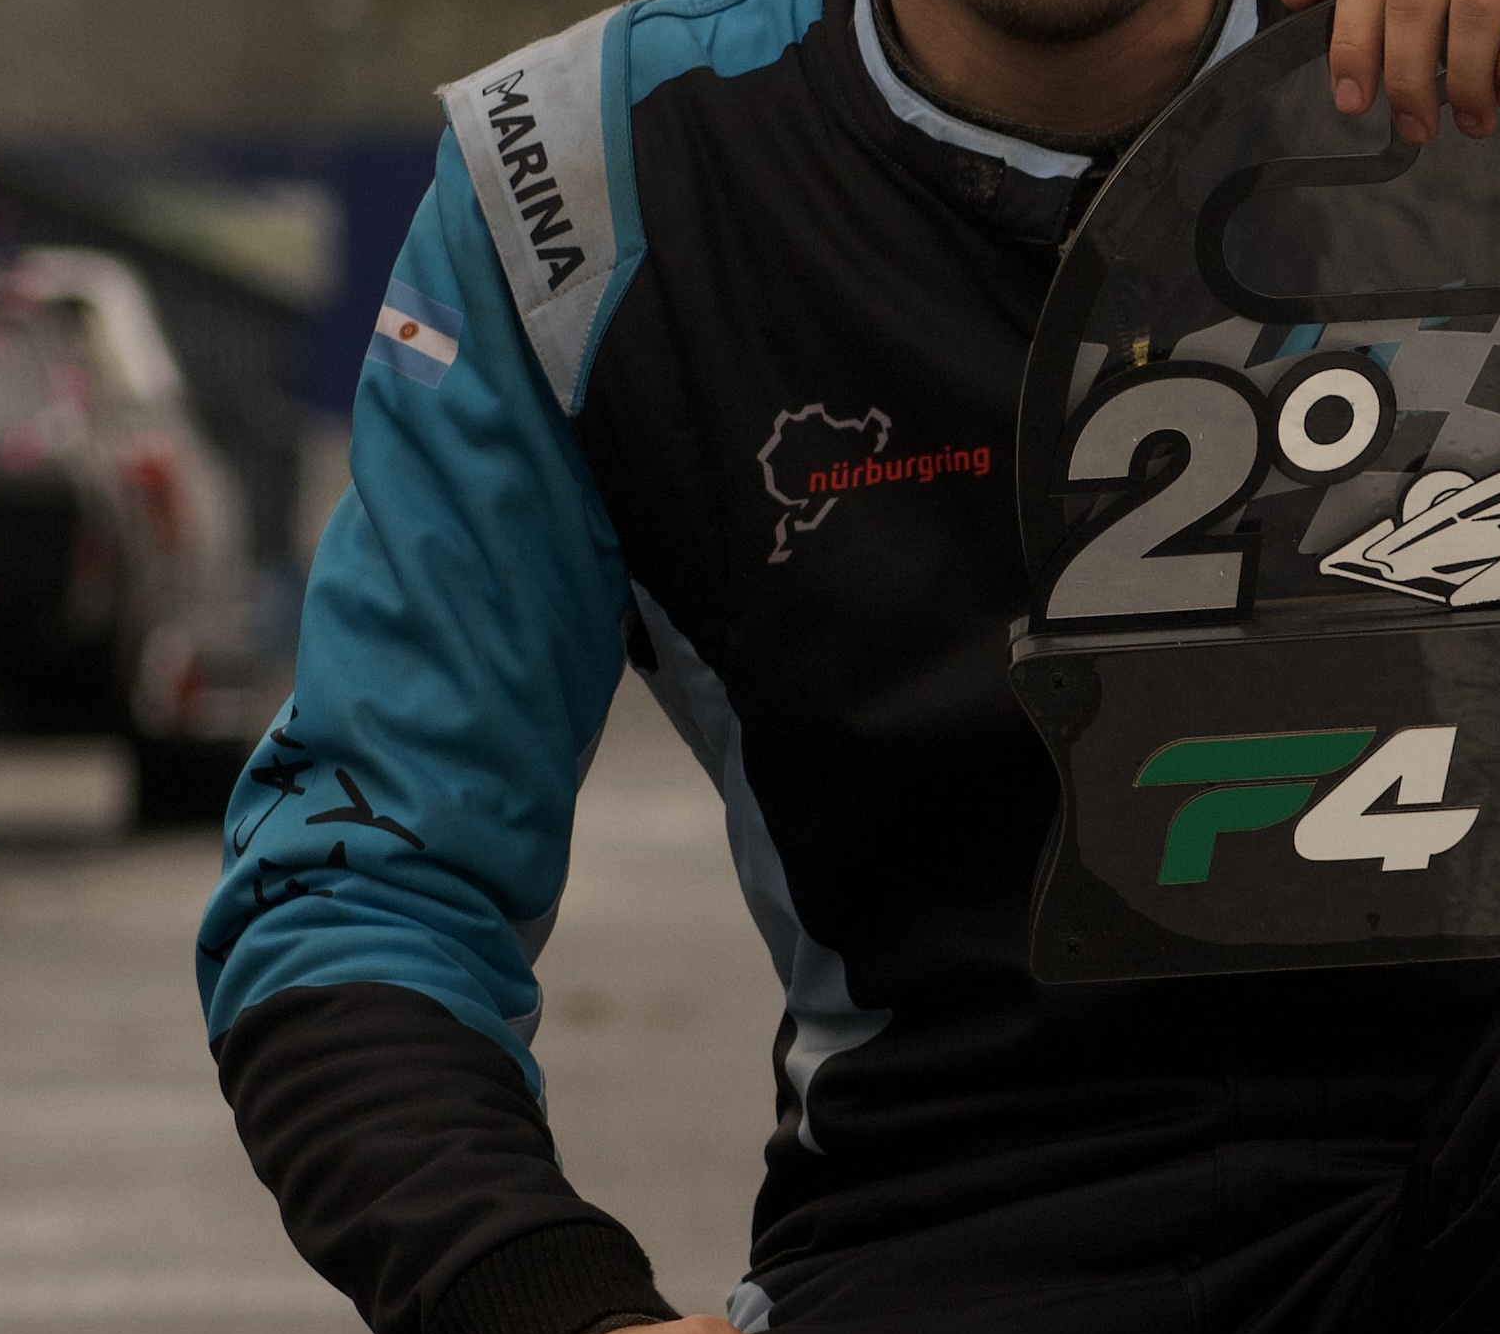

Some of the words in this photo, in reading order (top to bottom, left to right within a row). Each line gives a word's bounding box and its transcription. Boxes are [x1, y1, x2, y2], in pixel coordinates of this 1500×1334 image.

[481, 69, 586, 291] MARINA
[809, 445, 991, 493] nürburgring
[1133, 725, 1480, 886] F4
